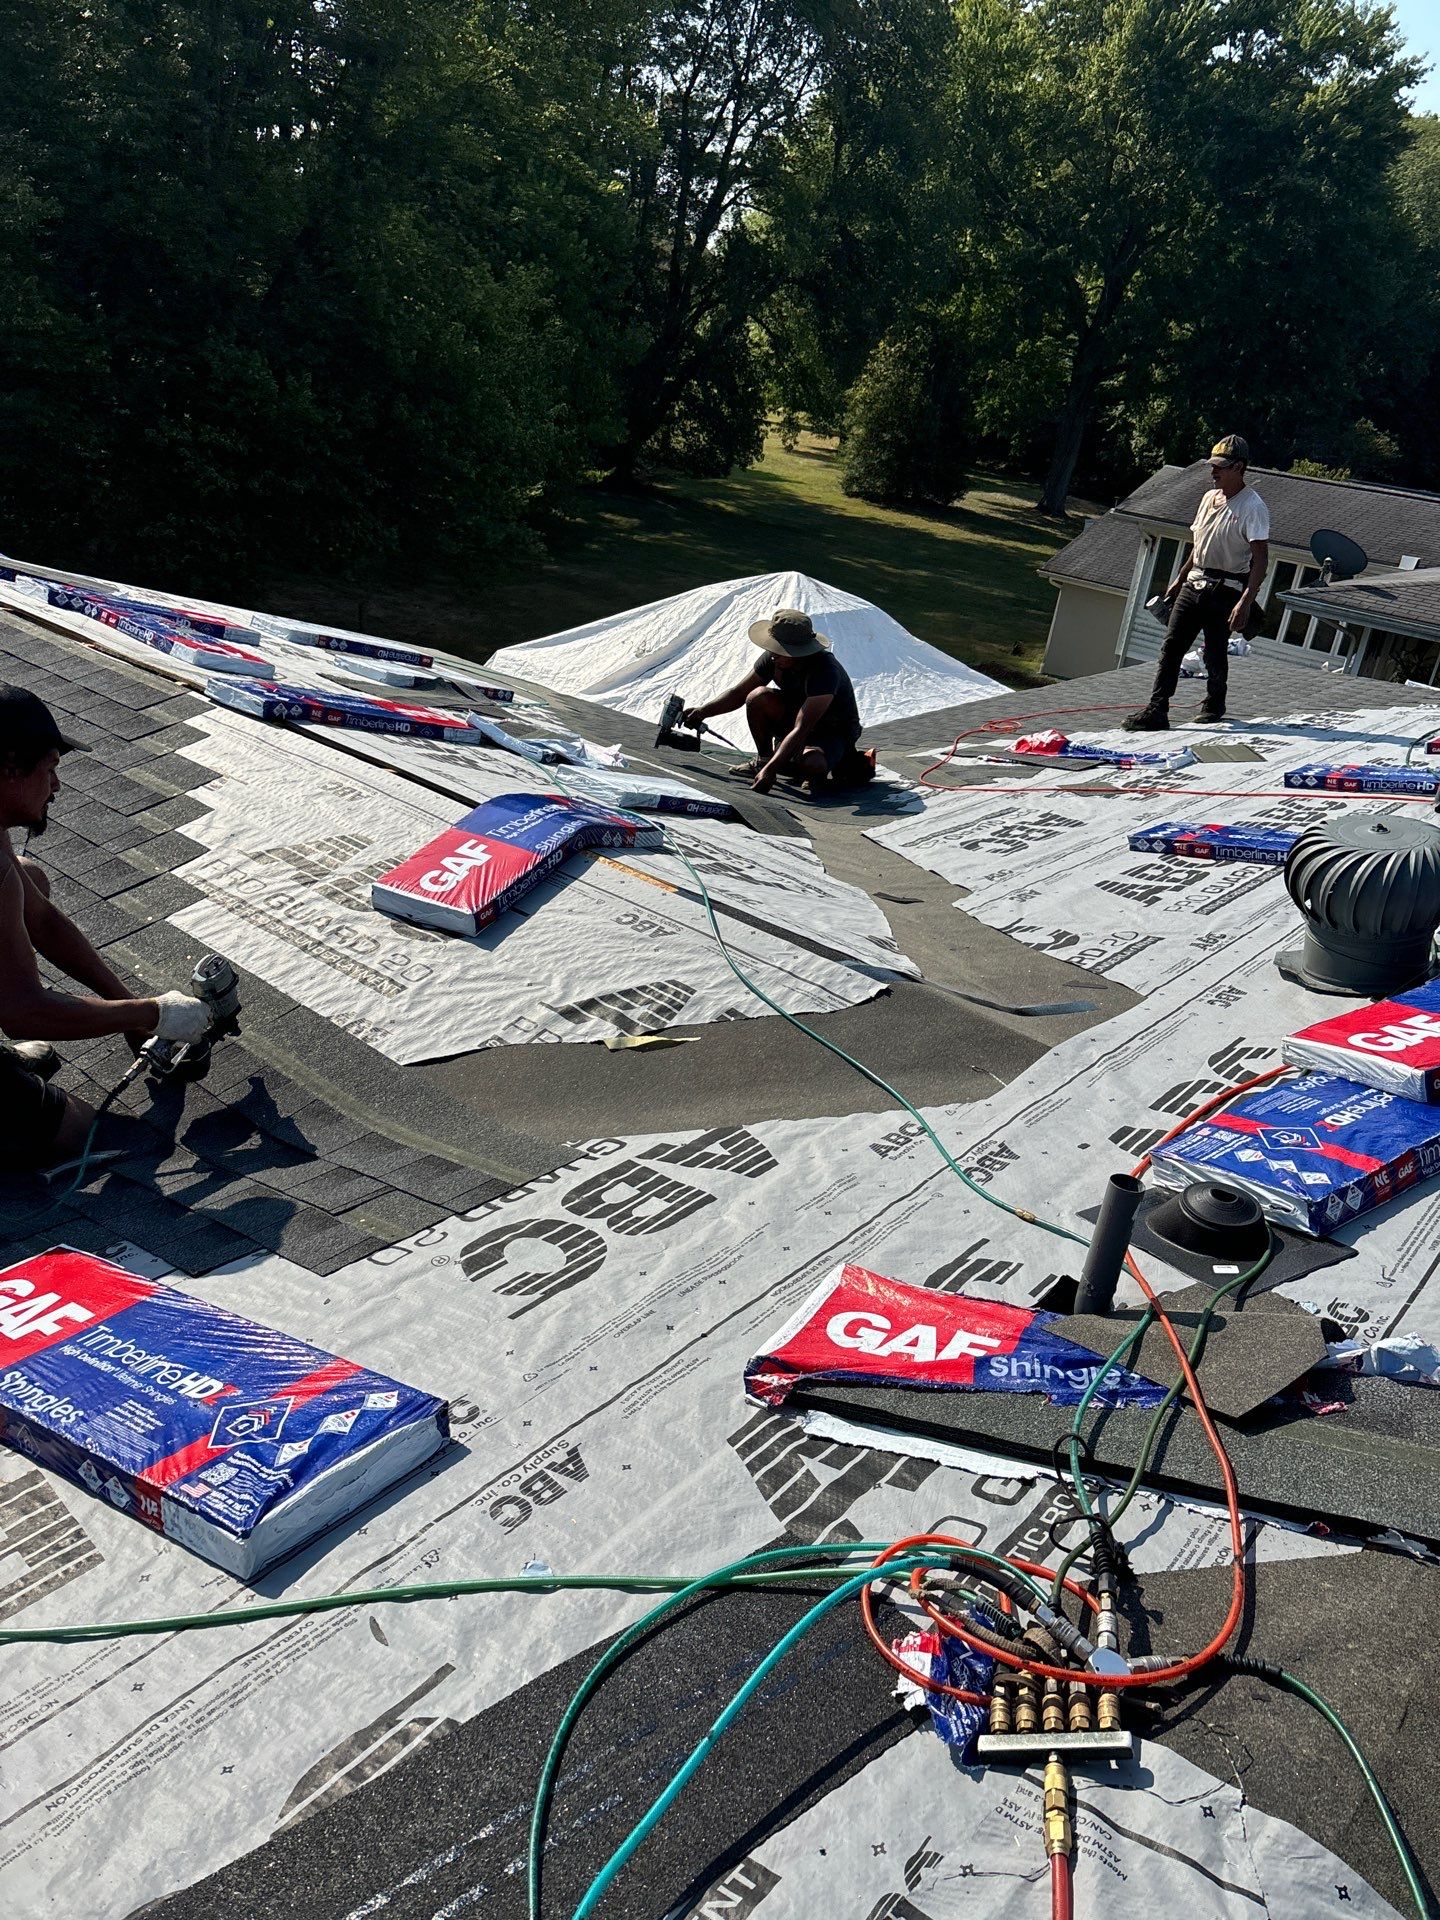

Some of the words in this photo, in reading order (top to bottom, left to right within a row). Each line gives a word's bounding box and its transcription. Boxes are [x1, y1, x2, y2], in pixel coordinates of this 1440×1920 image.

[327, 713, 342, 723] GAF
[1343, 781, 1358, 789] GAF
[419, 839, 493, 893] GAF
[1201, 865, 1265, 895] GUARD
[263, 892, 381, 954] GUARD
[378, 952, 434, 983] 20
[610, 912, 681, 938] ABC
[294, 935, 401, 995] UNDERLAYMENT
[1348, 1014, 1440, 1052] GAF
[869, 1120, 926, 1160] ABC
[962, 1139, 1021, 1186] ABC
[1398, 1161, 1415, 1180] GAF
[1374, 1170, 1390, 1187] NE
[459, 1124, 780, 1320] ABC
[825, 1311, 1002, 1361] GAF
[60, 1344, 79, 1358] High
[77, 1350, 117, 1374] Definition
[142, 1385, 178, 1406] Shingles
[989, 1356, 1141, 1390] Shingles
[1, 1370, 84, 1424] Shingles
[472, 1416, 498, 1429] inc.
[522, 1438, 570, 1474] Supply
[489, 1442, 590, 1536] ABC
[497, 1473, 522, 1488] Co.
[141, 1495, 159, 1516] NE
[470, 1488, 498, 1508] inc.
[266, 1618, 314, 1654] OVERLAP
[239, 1649, 266, 1670] LINE
[158, 1697, 194, 1726] LÍNEA
[140, 1722, 160, 1739] DE
[44, 1736, 143, 1814] SUPERPOSICIÓN
[1012, 1784, 1033, 1800] and
[1005, 1811, 1033, 1831] ASTM
[1081, 1847, 1097, 1858] the
[1092, 1839, 1122, 1863] ASTM
[1099, 1855, 1128, 1881] Meets
